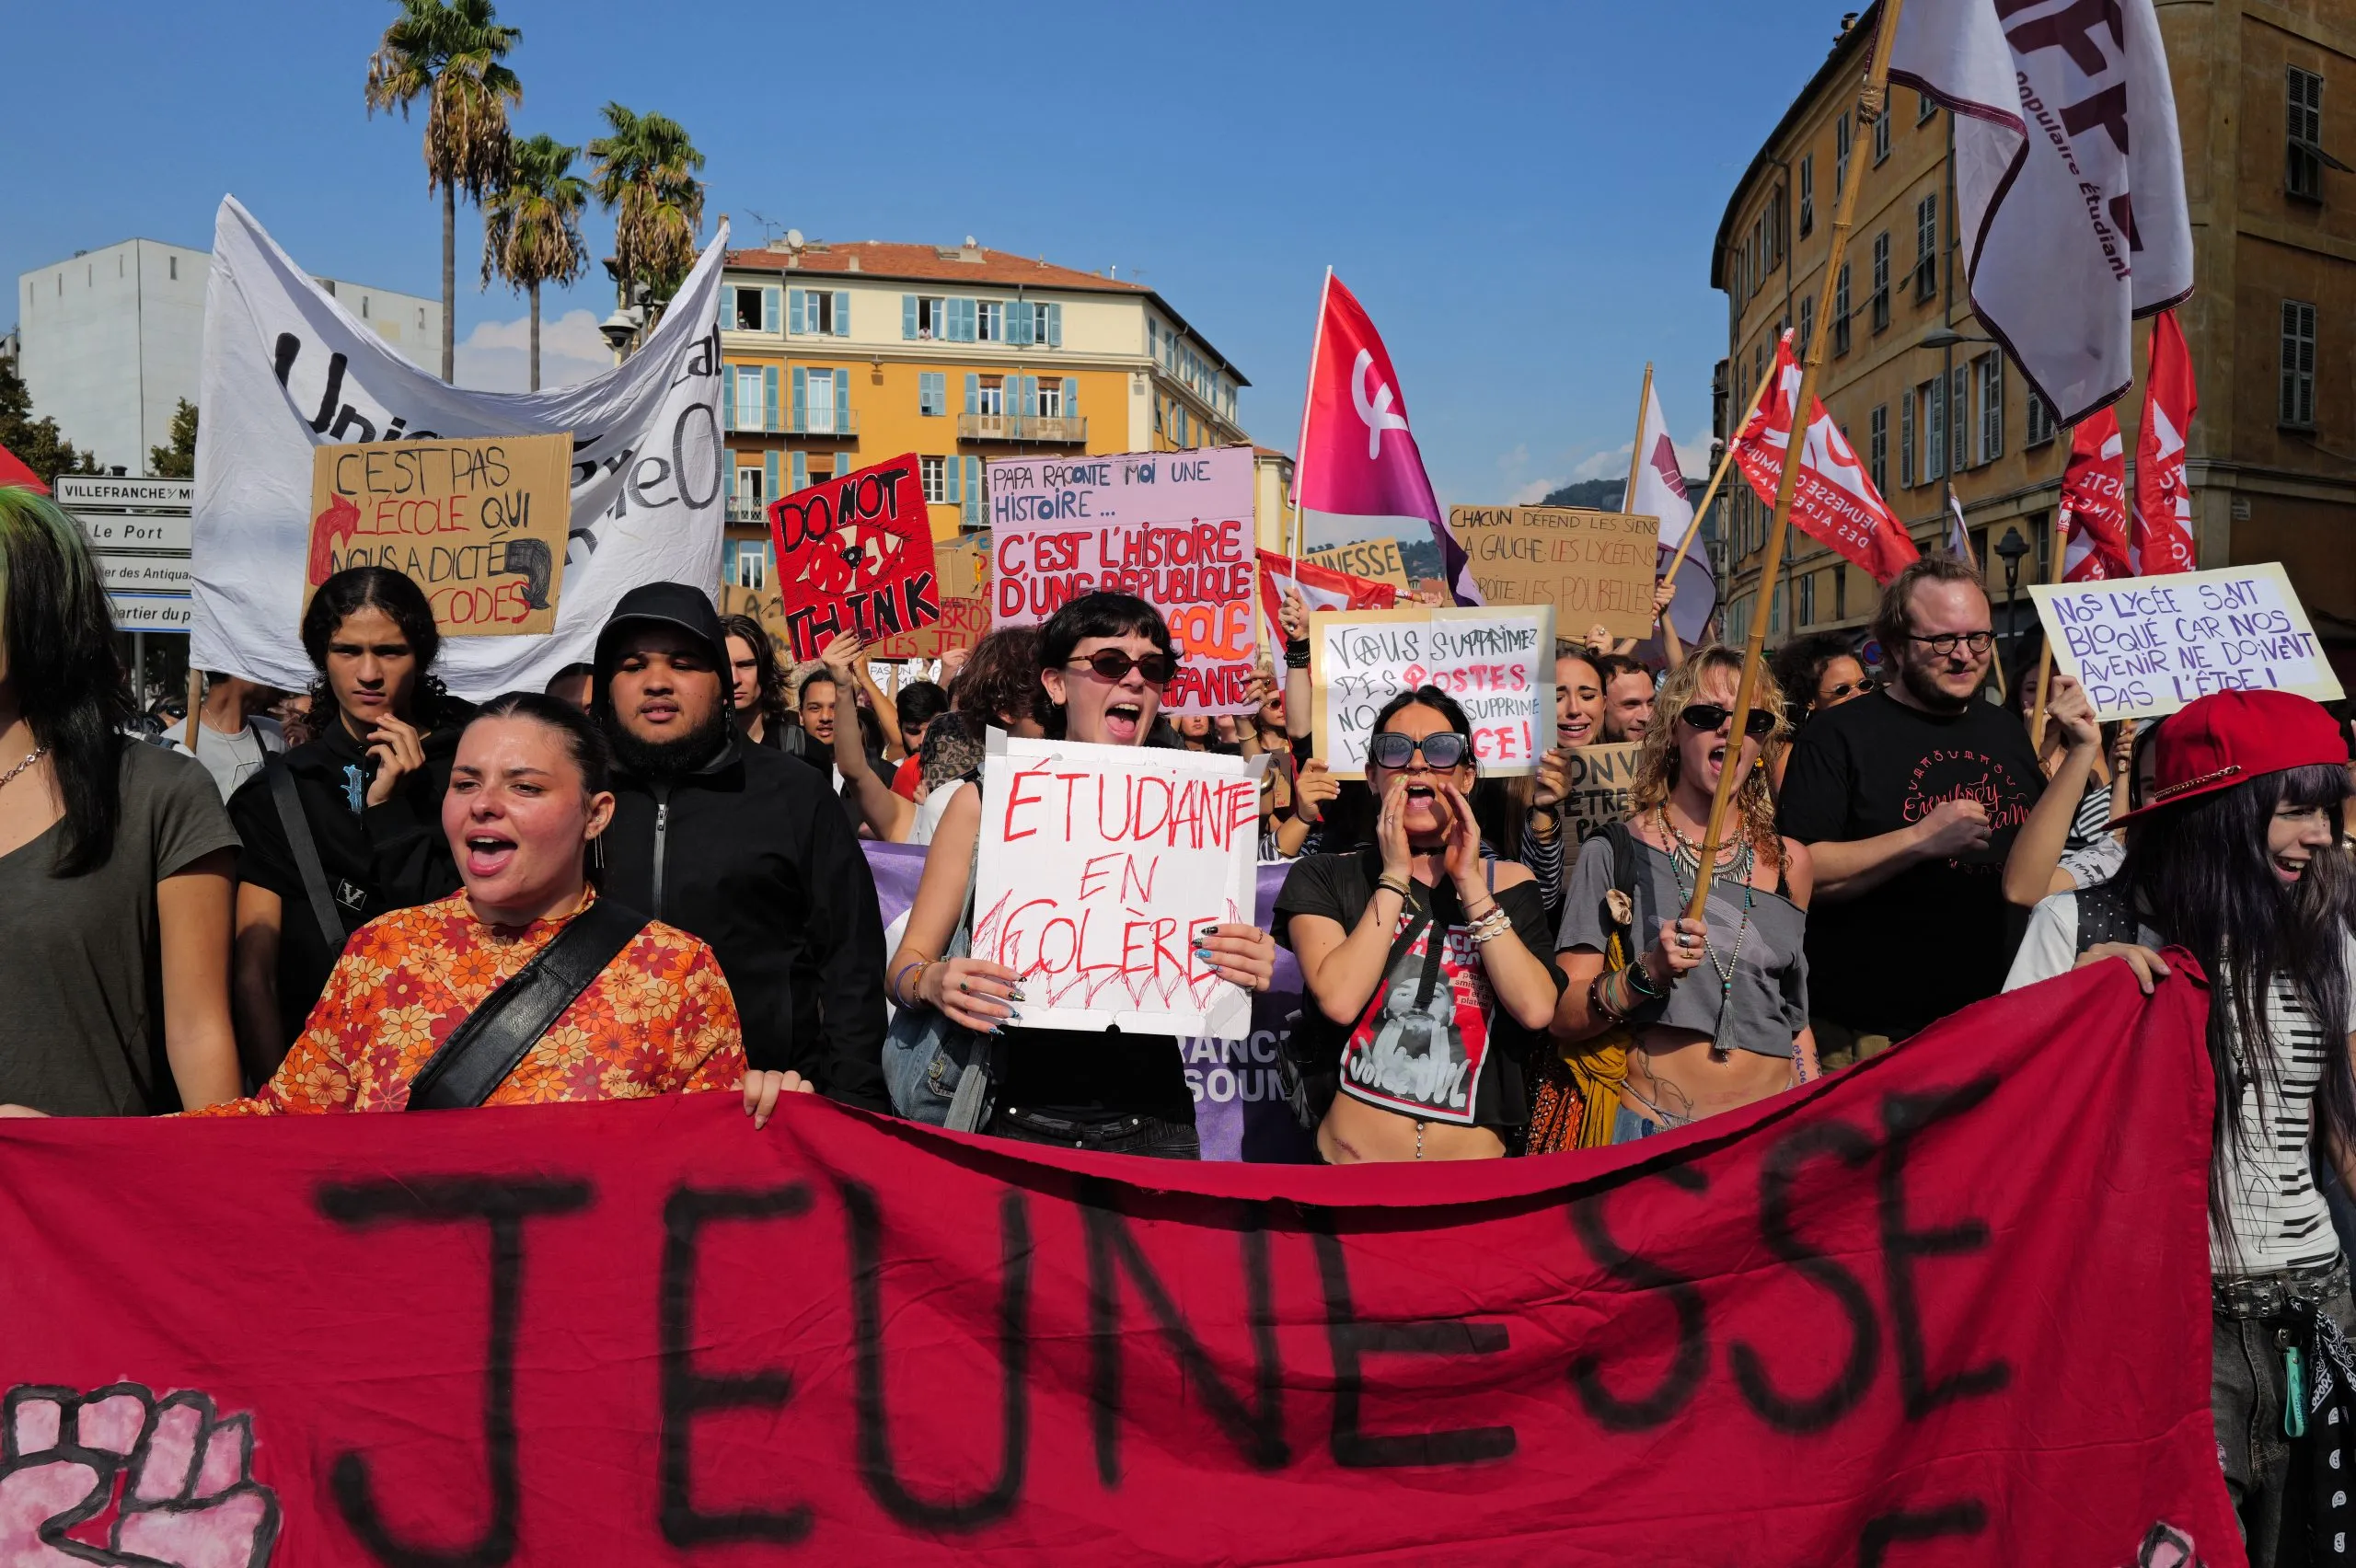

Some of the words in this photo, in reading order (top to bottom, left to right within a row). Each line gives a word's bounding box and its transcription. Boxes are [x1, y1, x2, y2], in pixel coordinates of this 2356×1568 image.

[337, 447, 447, 495] C'EST
[451, 446, 510, 494] PAS
[993, 467, 1034, 491] PAPA
[1044, 464, 1111, 488] RACONTE
[1171, 461, 1211, 483] UNE
[64, 485, 167, 499] VILLEFRANCHE
[779, 495, 832, 554] DO
[837, 467, 910, 525] NOT
[94, 525, 112, 538] Le
[124, 525, 163, 539] Port
[353, 491, 470, 536] L'ÉCOLE
[481, 490, 530, 529] QUI
[1450, 509, 1512, 528] CHACUN
[1523, 510, 1580, 528] DÉFEND
[1589, 517, 1617, 531] LES
[102, 570, 116, 578] er
[120, 567, 140, 578] des
[407, 548, 425, 582] A
[428, 530, 509, 582] DICTÉ
[998, 531, 1092, 577] C'EST
[1551, 539, 1579, 562] LES
[1586, 539, 1655, 567] LYCÉENS
[116, 606, 157, 620] artier
[162, 607, 179, 621] du
[1522, 580, 1555, 605] LES
[1562, 576, 1654, 615] POUBELLES
[2109, 585, 2182, 619] LYCÉE
[785, 571, 941, 662] THINK
[1169, 601, 1254, 663] AQUE
[2063, 617, 2167, 658] BLOQUÉ
[2176, 616, 2224, 643] CAR
[2227, 610, 2292, 637] NOS
[2178, 645, 2212, 670] NE
[1334, 669, 1398, 703] DES
[2090, 680, 2154, 713] PAS
[1464, 697, 1540, 721] SUPPRIME
[1473, 721, 1532, 760] GE!
[1004, 757, 1260, 852] ÉTUDIANTE
[1078, 852, 1159, 904] EN
[318, 1075, 2012, 1562] JEUNESSE
